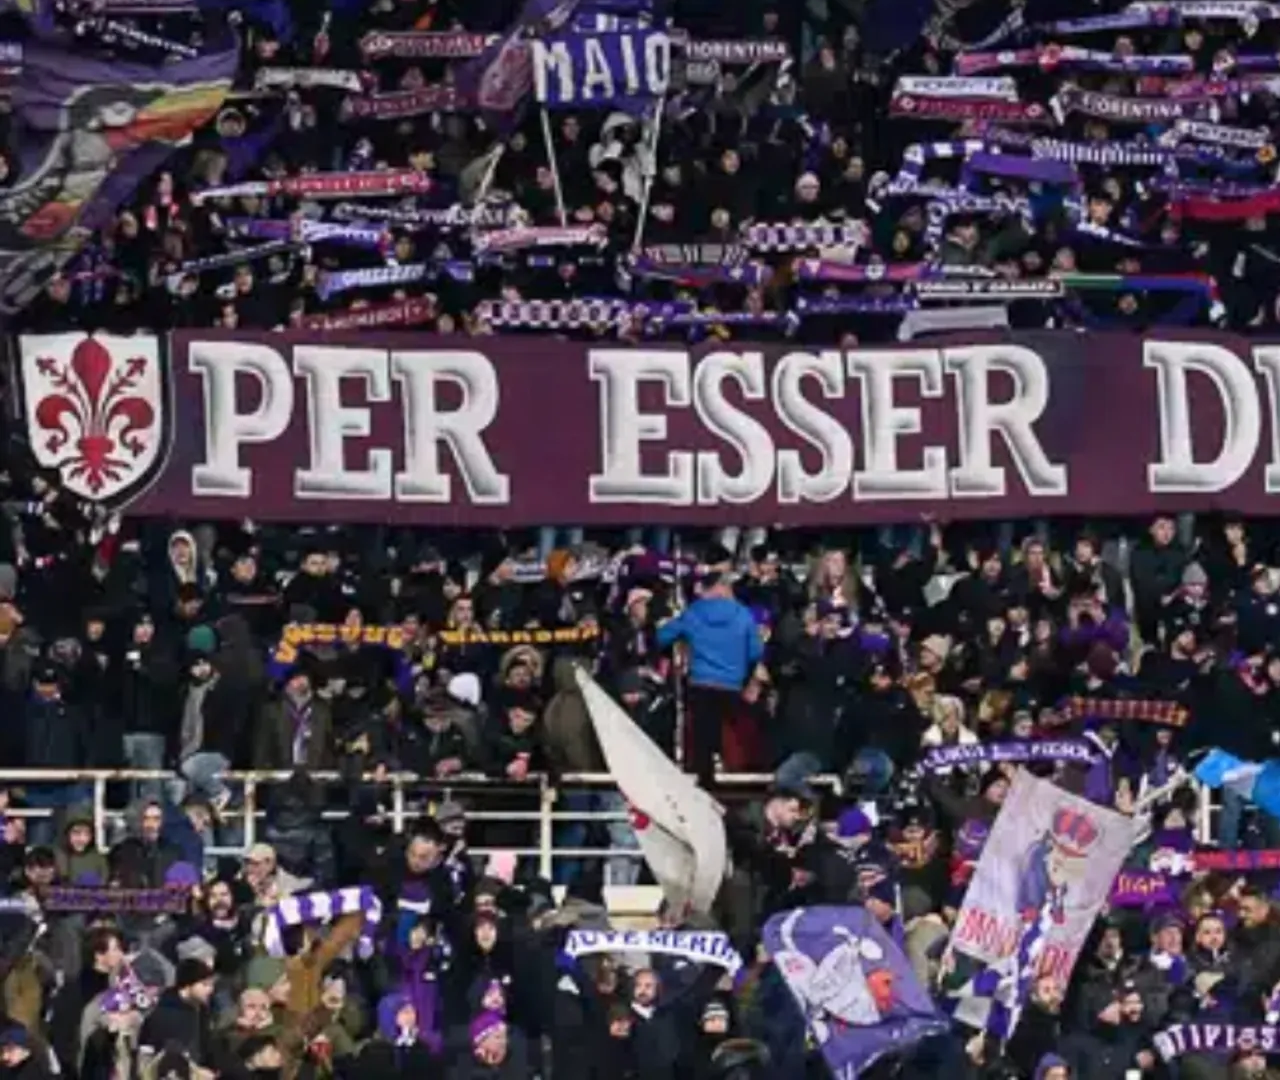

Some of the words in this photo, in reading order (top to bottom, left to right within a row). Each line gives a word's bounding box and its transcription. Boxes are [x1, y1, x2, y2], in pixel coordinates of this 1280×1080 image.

[532, 31, 670, 102] MAIO
[686, 40, 785, 58] FIORENTINA
[187, 340, 510, 505] PER
[588, 344, 1068, 507] ESSER
